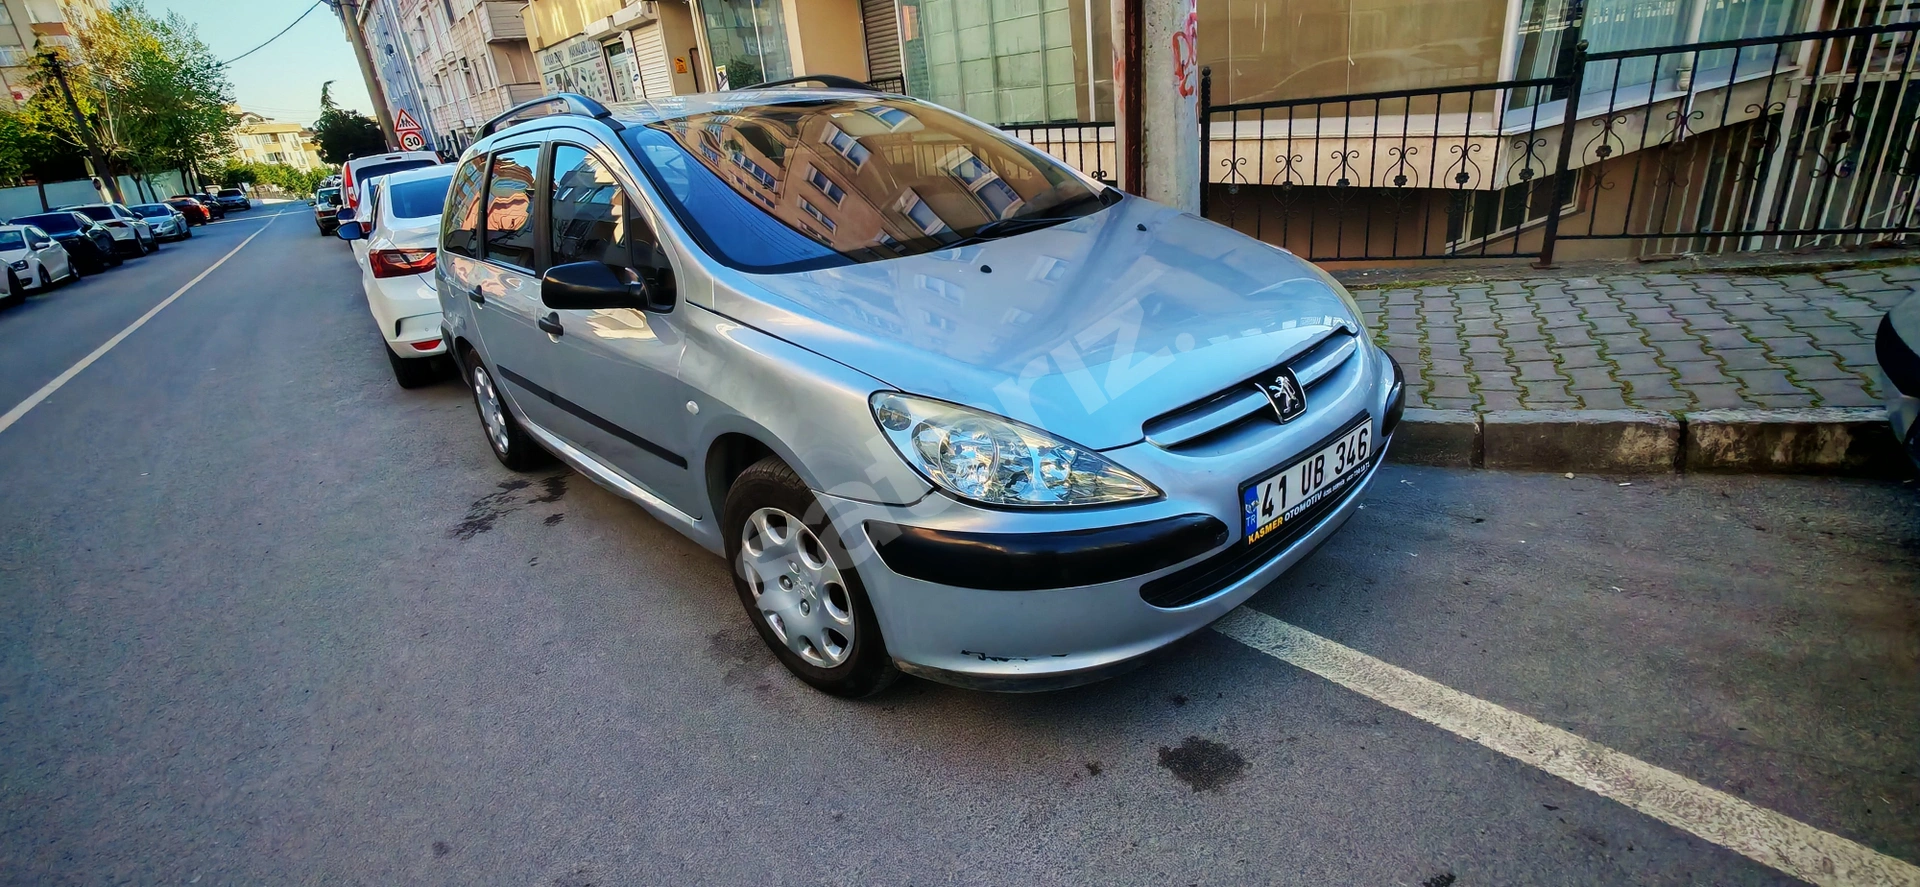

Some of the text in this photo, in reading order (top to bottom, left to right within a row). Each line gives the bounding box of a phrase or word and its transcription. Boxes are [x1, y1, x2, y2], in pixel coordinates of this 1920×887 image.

[405, 136, 420, 147] 30
[1262, 475, 1287, 518] 41
[1301, 454, 1325, 496] UB
[1334, 427, 1368, 475] 346
[1245, 513, 1256, 528] TR
[1248, 516, 1284, 545] KASMER
